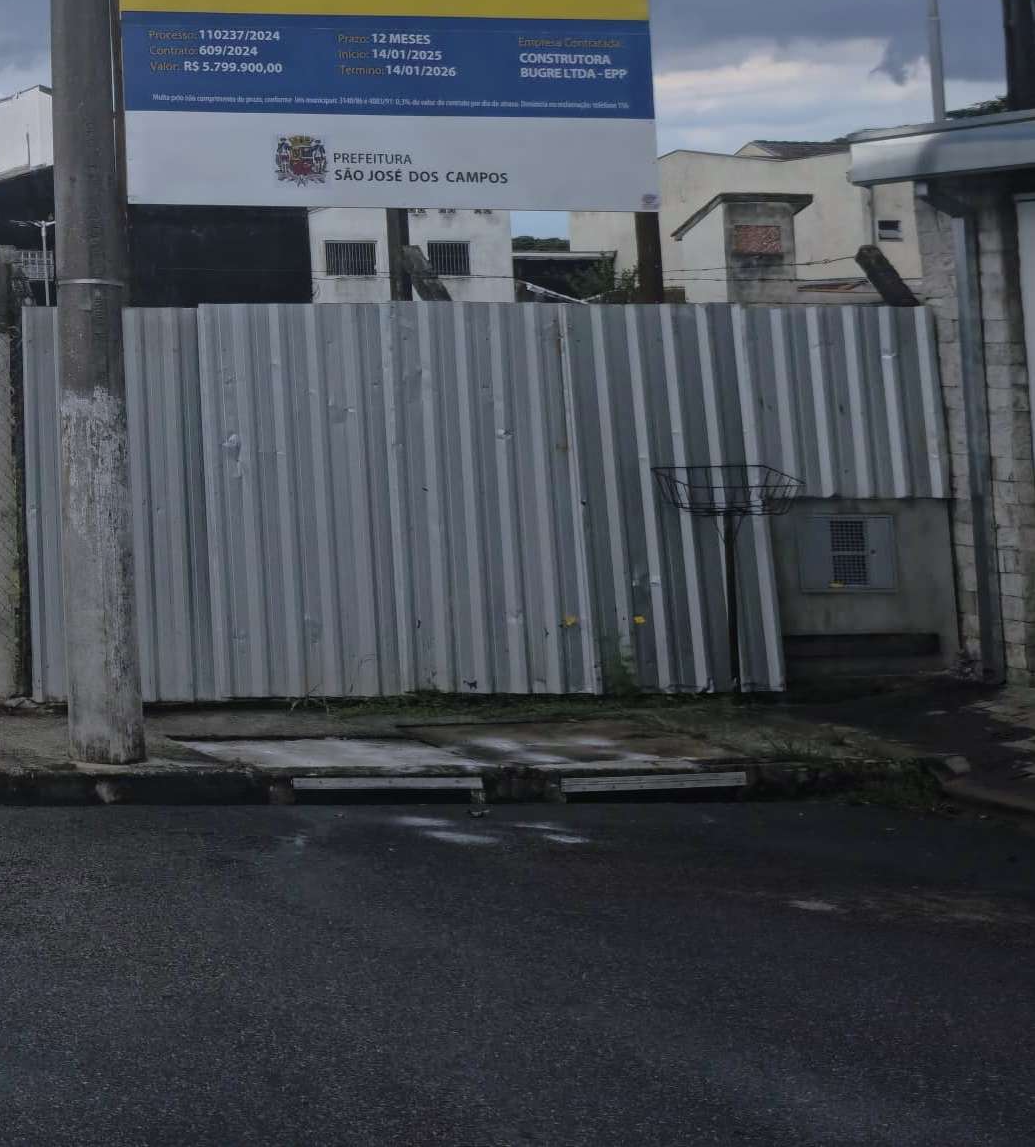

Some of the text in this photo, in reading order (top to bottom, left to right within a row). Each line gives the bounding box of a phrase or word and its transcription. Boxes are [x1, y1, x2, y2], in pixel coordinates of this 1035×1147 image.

[199, 30, 280, 41] 110237/2024
[372, 33, 386, 44] 12
[390, 34, 430, 45] MESES
[199, 45, 258, 56] 609/2024
[372, 48, 442, 61] 14/01/2025
[519, 53, 611, 65] CONSTRUTORA
[184, 60, 199, 72] R$
[203, 62, 283, 74] 5.799.900,00
[386, 65, 456, 77] 14/01/2026
[520, 68, 561, 79] BUGRE
[564, 69, 595, 79] LTDA
[604, 69, 628, 80] EPP
[334, 152, 412, 165] PREFEITURA
[335, 167, 508, 184] SÃO JOSÉ DOS CAMPOS
